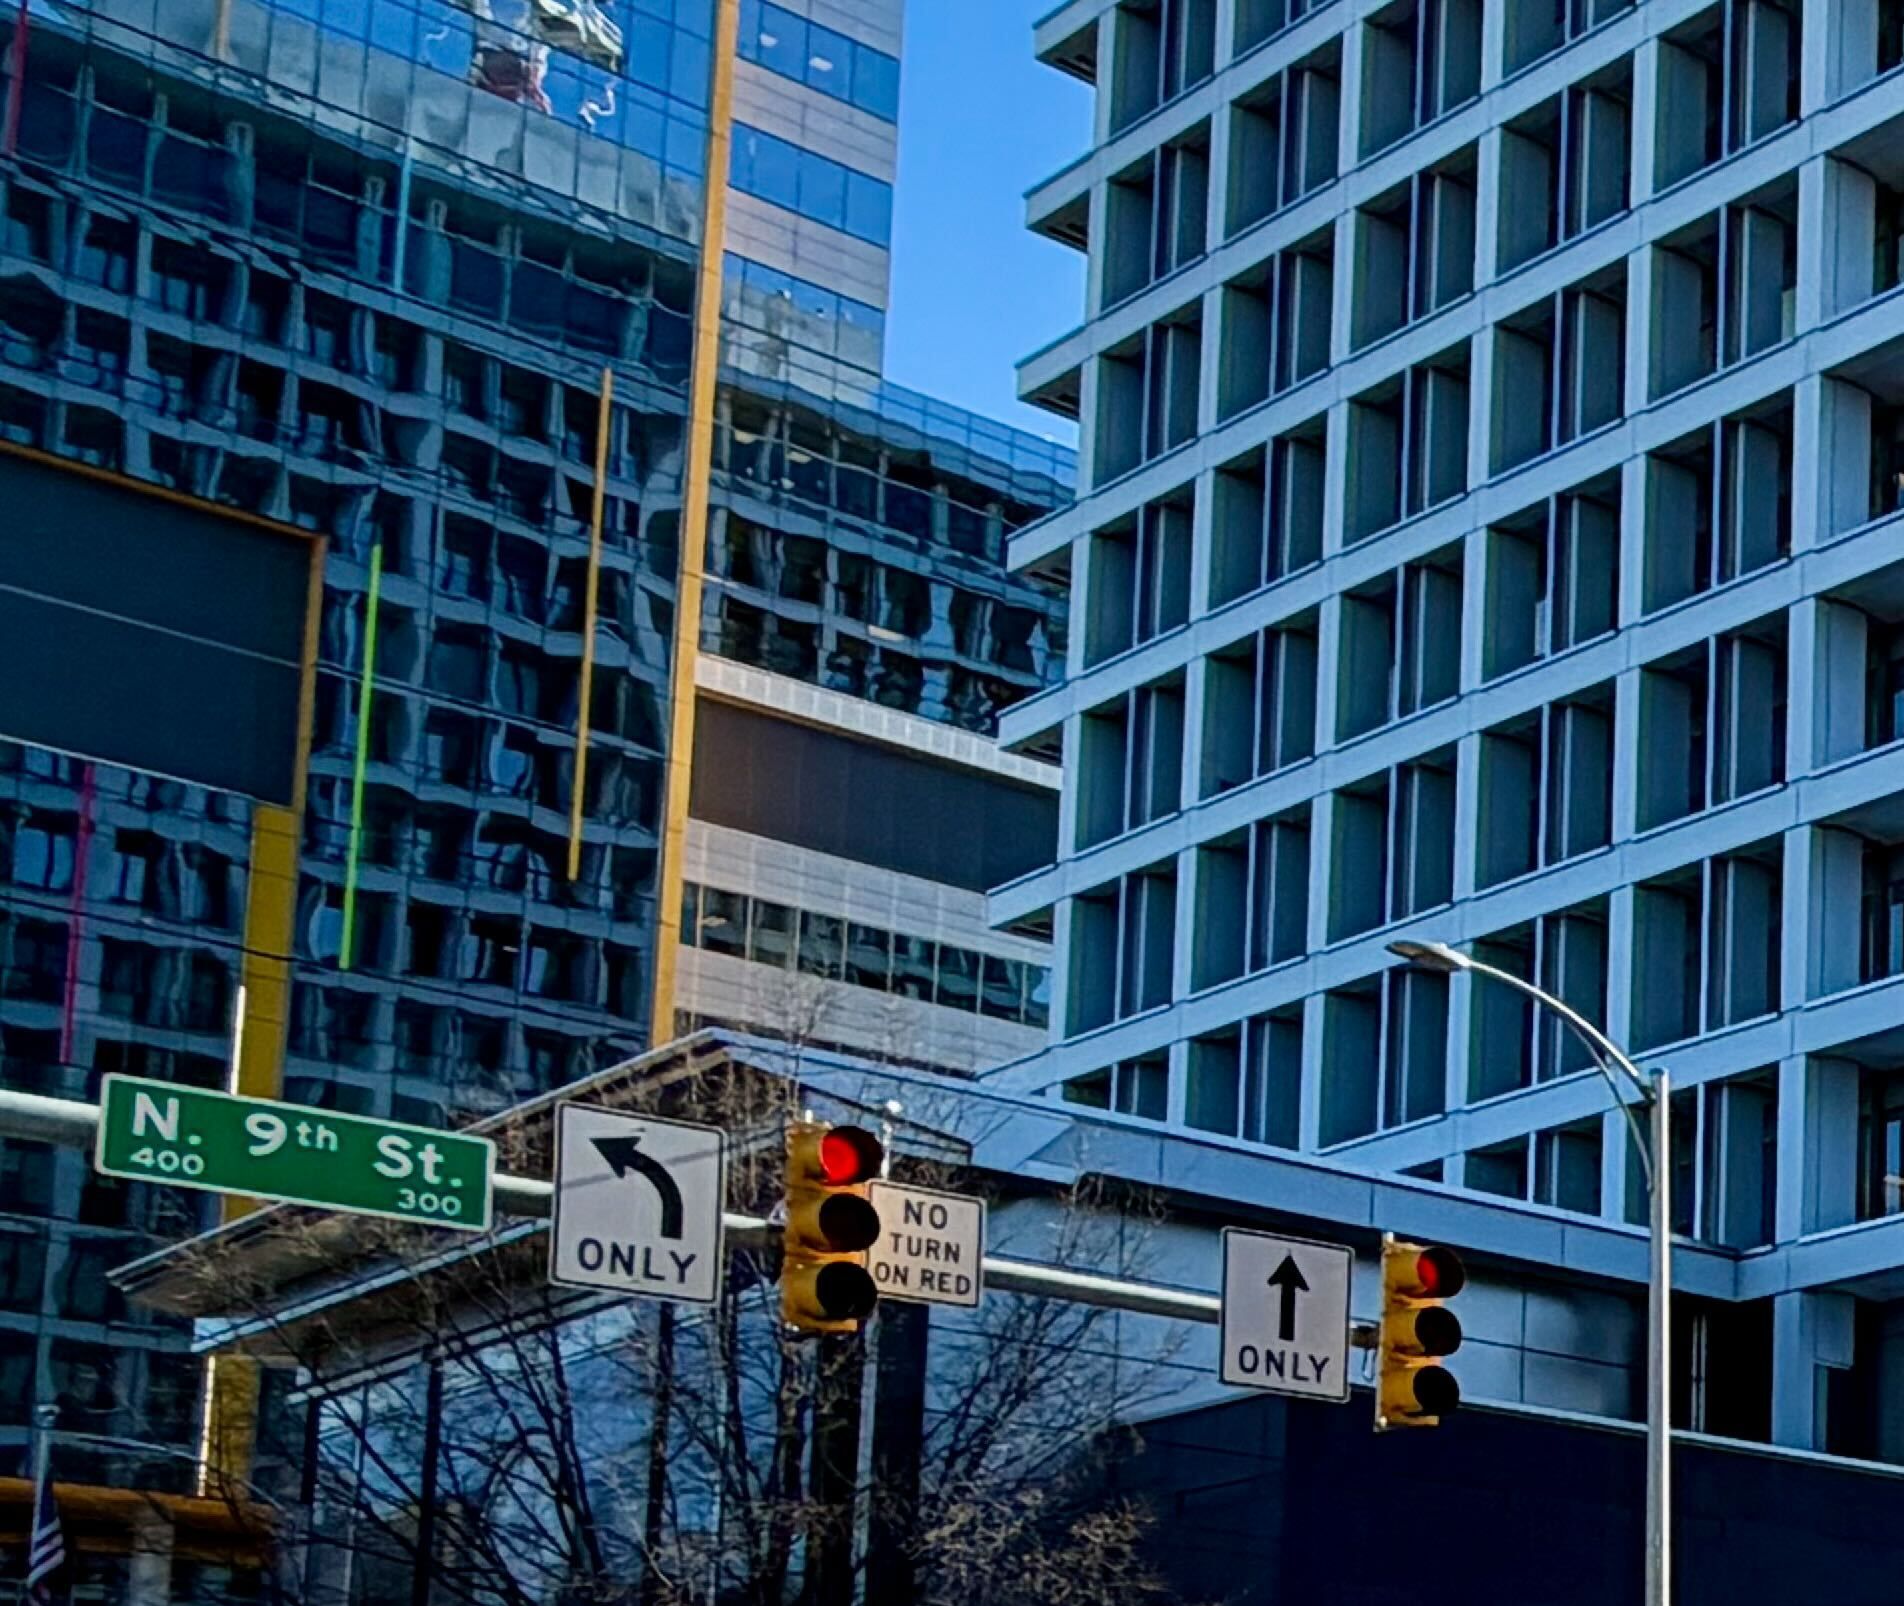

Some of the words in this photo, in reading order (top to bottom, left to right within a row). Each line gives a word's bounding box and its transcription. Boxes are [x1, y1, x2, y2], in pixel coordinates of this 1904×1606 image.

[132, 1091, 202, 1146] N.
[245, 1111, 338, 1157] 9th
[372, 1134, 463, 1188] St.
[129, 1147, 205, 1176] 400
[397, 1187, 462, 1217] 300
[903, 1197, 948, 1231] NO
[577, 1237, 697, 1285] ONLY
[890, 1231, 961, 1265] TURN
[874, 1261, 909, 1288] ON
[919, 1267, 972, 1296] RED
[1238, 1344, 1331, 1384] ONLY
